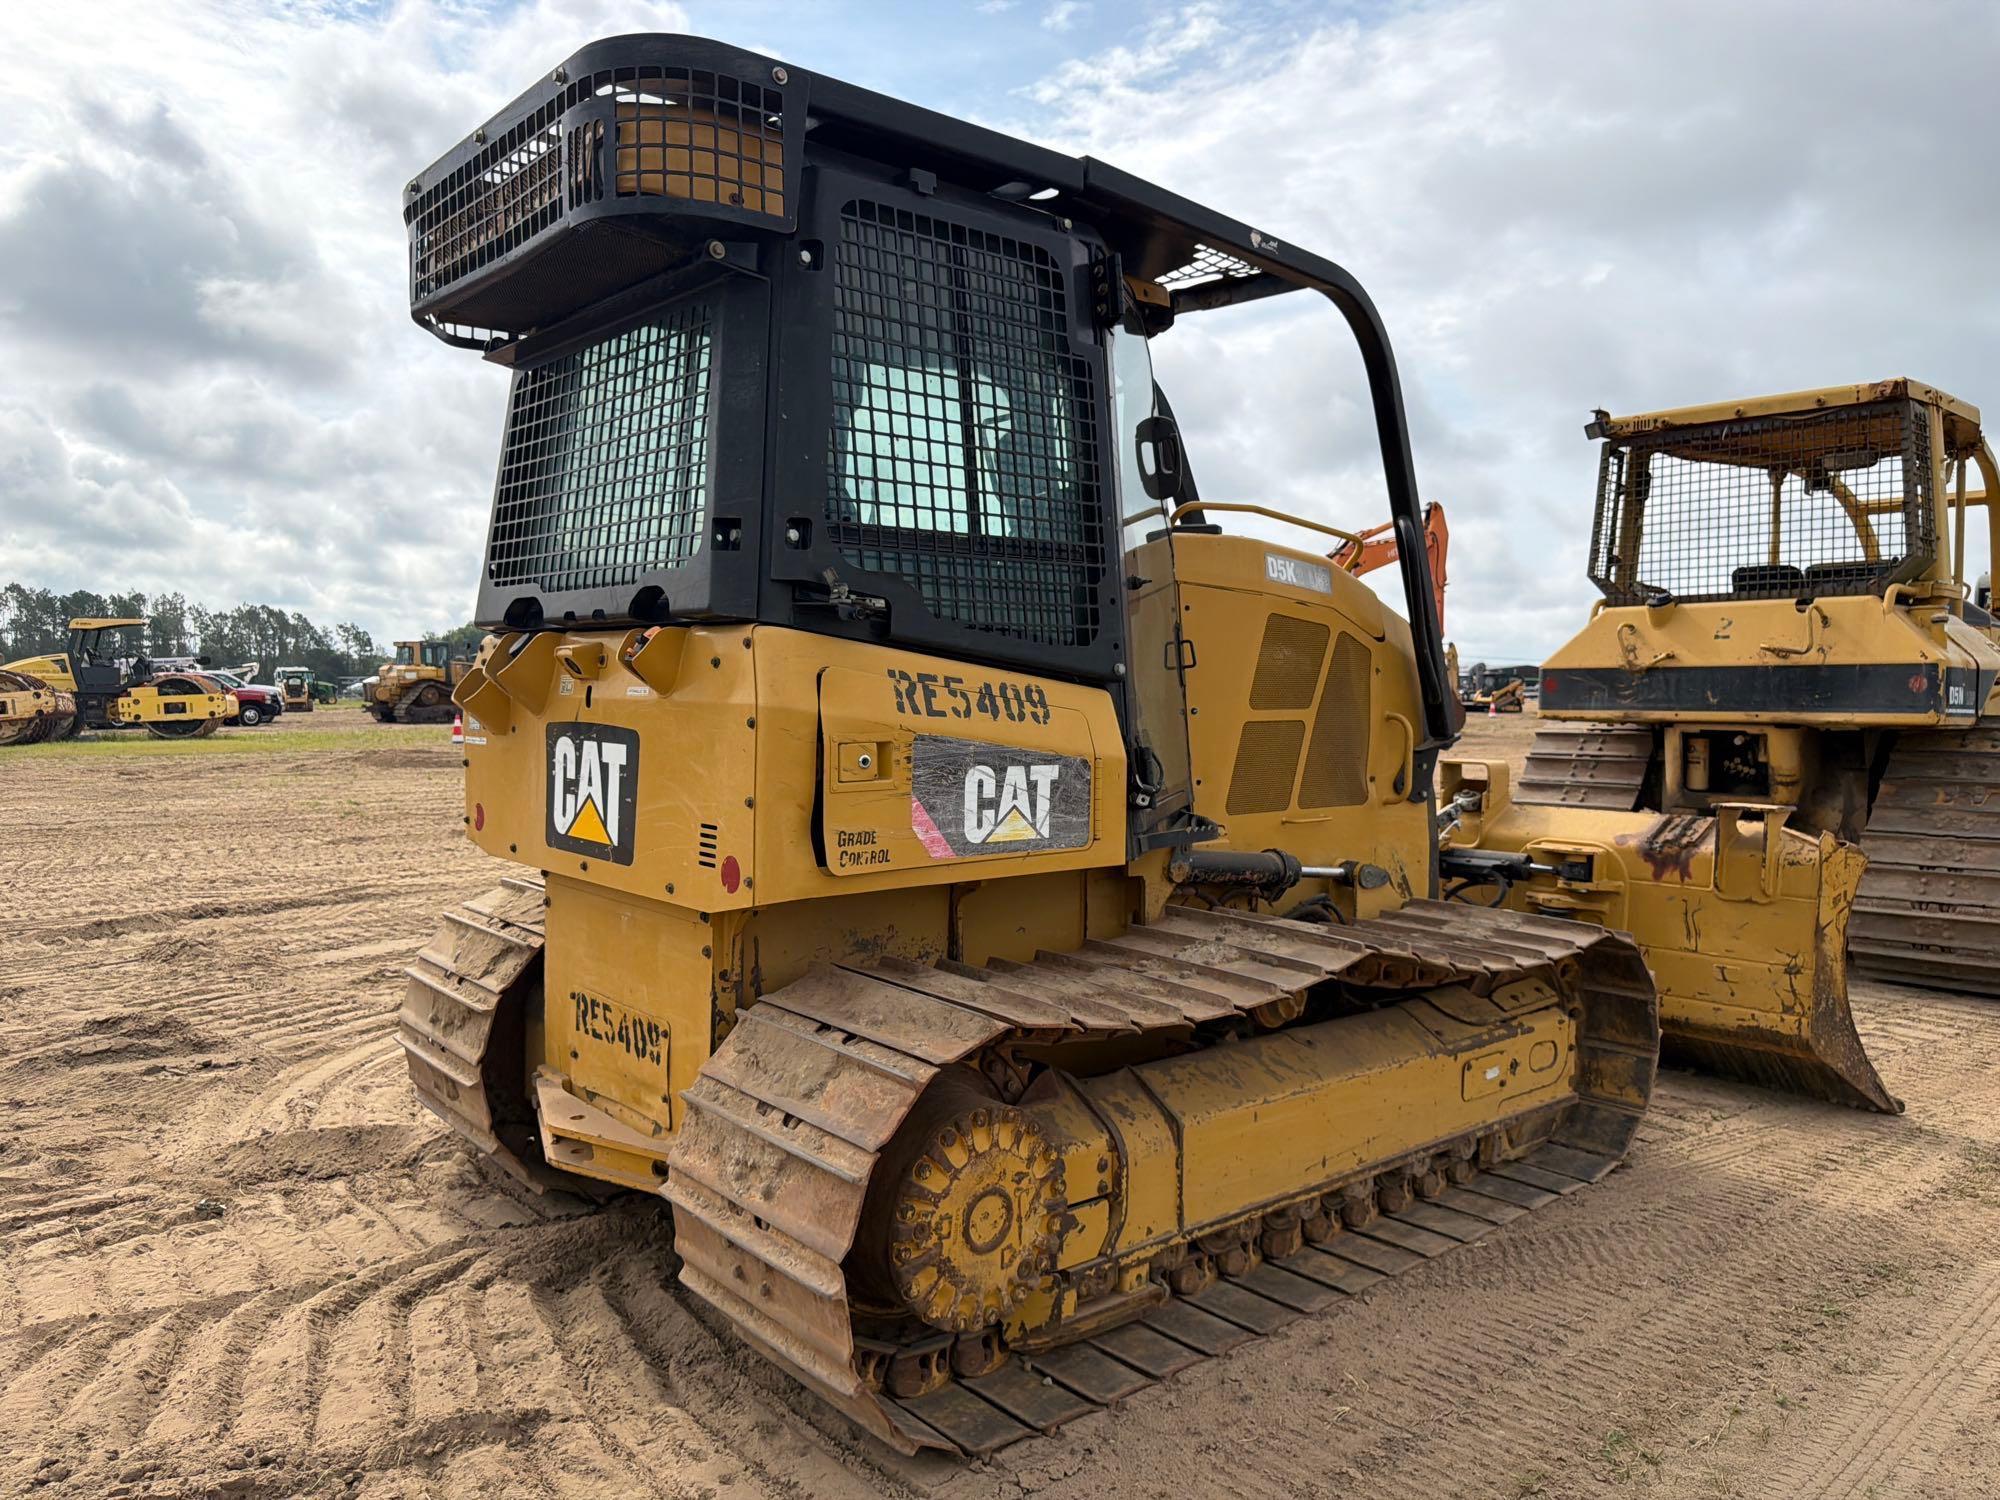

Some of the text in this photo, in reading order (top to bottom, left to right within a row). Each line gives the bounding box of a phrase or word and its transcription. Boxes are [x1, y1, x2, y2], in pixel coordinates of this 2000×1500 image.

[1267, 556, 1297, 583] D5K
[887, 668, 1051, 725] RE5409
[553, 736, 628, 847] CAT
[964, 764, 1060, 844] CAT
[838, 830, 877, 848] GRADE
